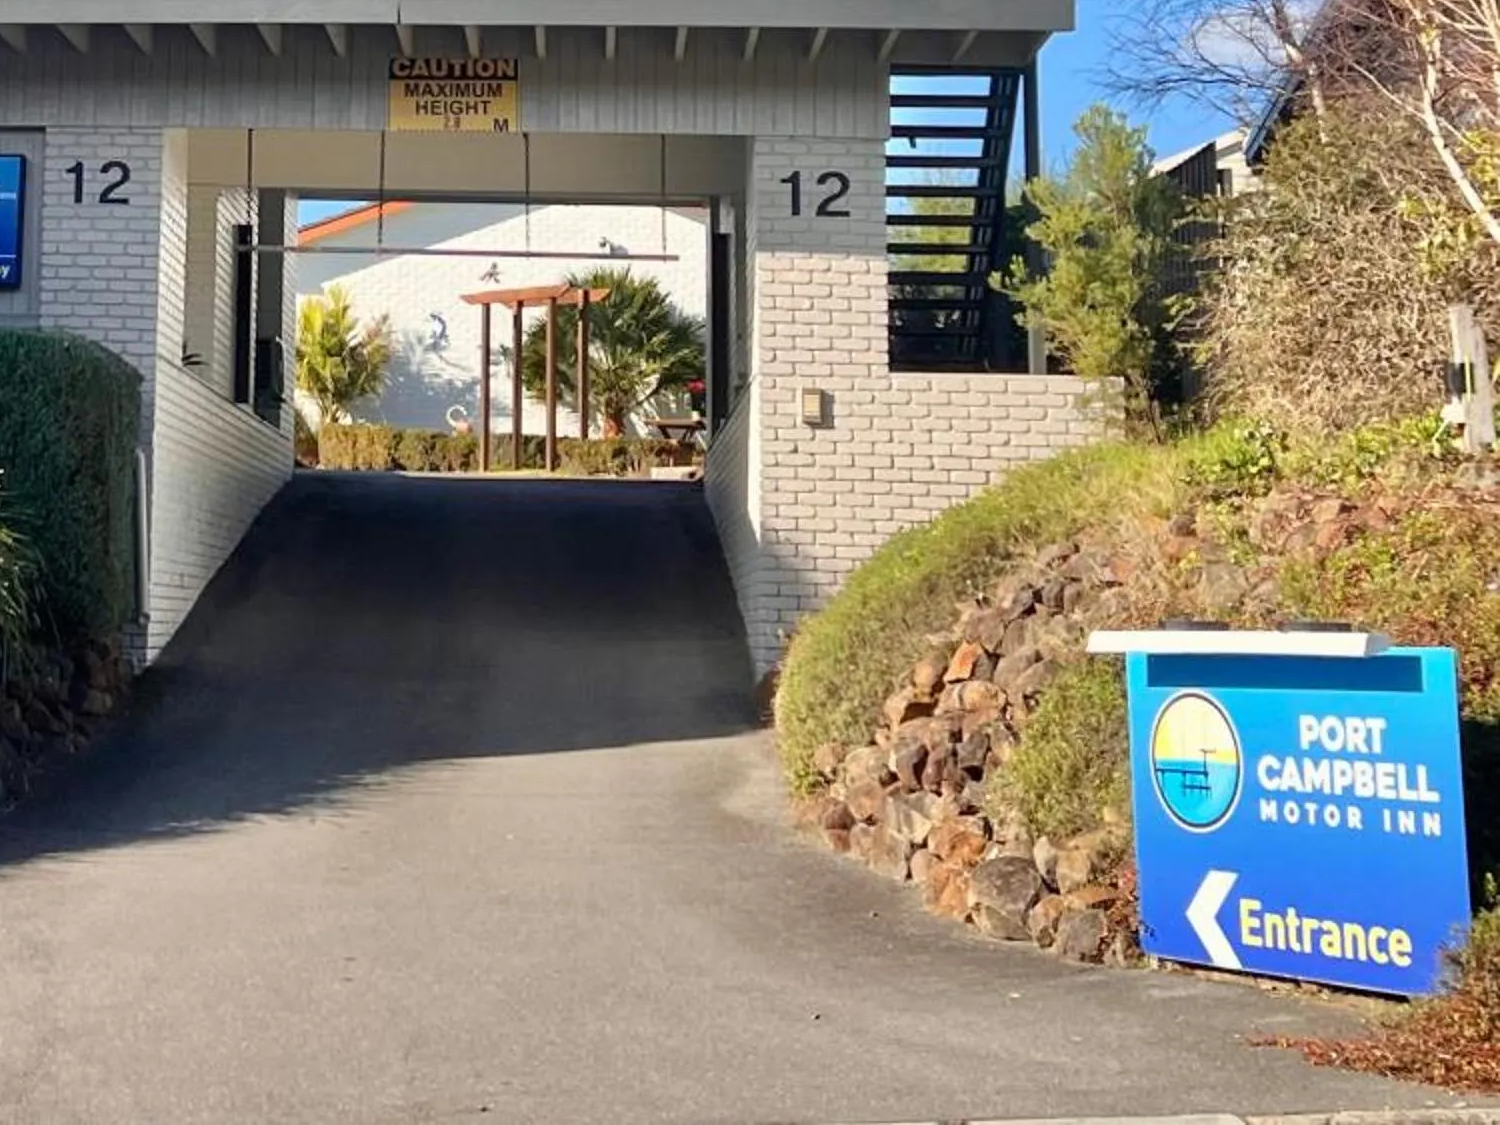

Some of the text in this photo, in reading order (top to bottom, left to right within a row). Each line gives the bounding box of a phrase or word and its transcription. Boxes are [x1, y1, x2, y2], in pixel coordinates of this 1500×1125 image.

[392, 58, 515, 77] CAUTION
[404, 82, 503, 98] MAXIMUM
[415, 100, 492, 116] HEIGHT
[493, 118, 509, 133] M
[65, 160, 131, 204] 12
[780, 170, 851, 217] 12
[1299, 714, 1387, 755] PORT
[1257, 754, 1441, 803] CAMPBELL
[1259, 799, 1442, 837] MOTOR INN
[1238, 898, 1413, 968] Entrance
